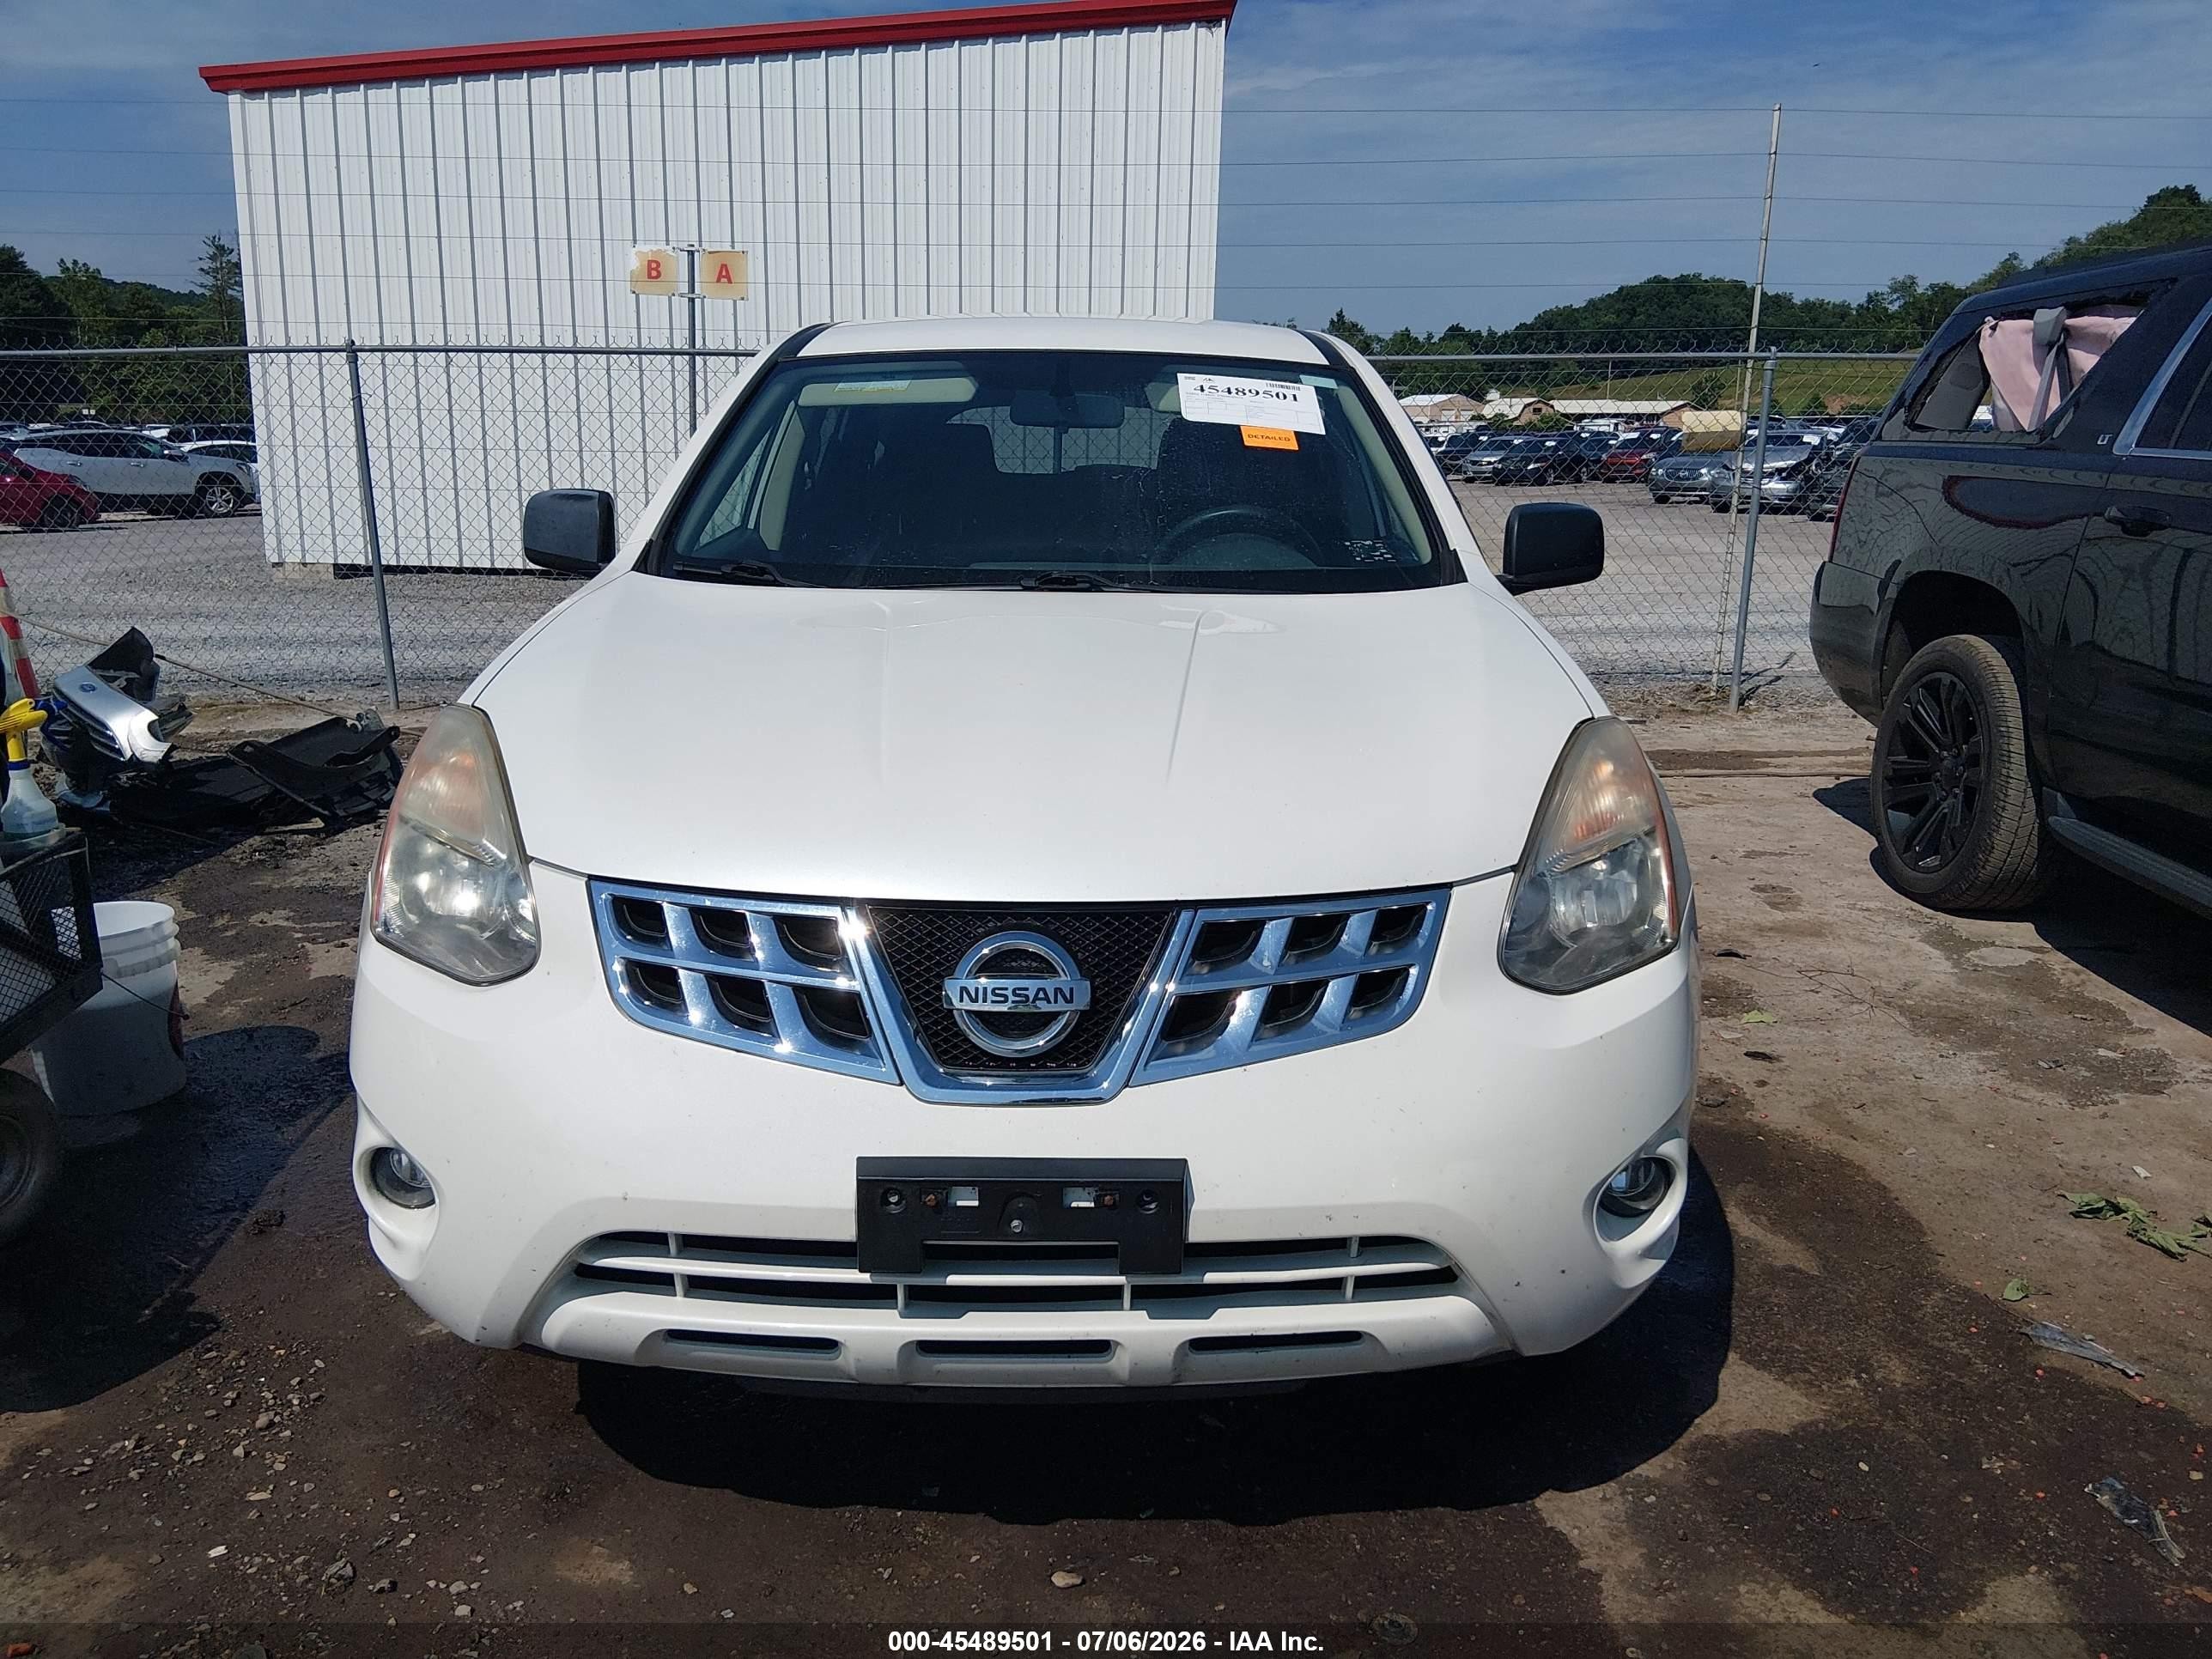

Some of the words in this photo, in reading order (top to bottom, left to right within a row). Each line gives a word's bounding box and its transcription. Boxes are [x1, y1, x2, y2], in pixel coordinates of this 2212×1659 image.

[647, 259, 662, 279] B
[715, 264, 733, 284] A
[1194, 384, 1299, 402] 45489501
[1248, 434, 1291, 442] DETAILED
[958, 986, 1074, 1005] NISSAN
